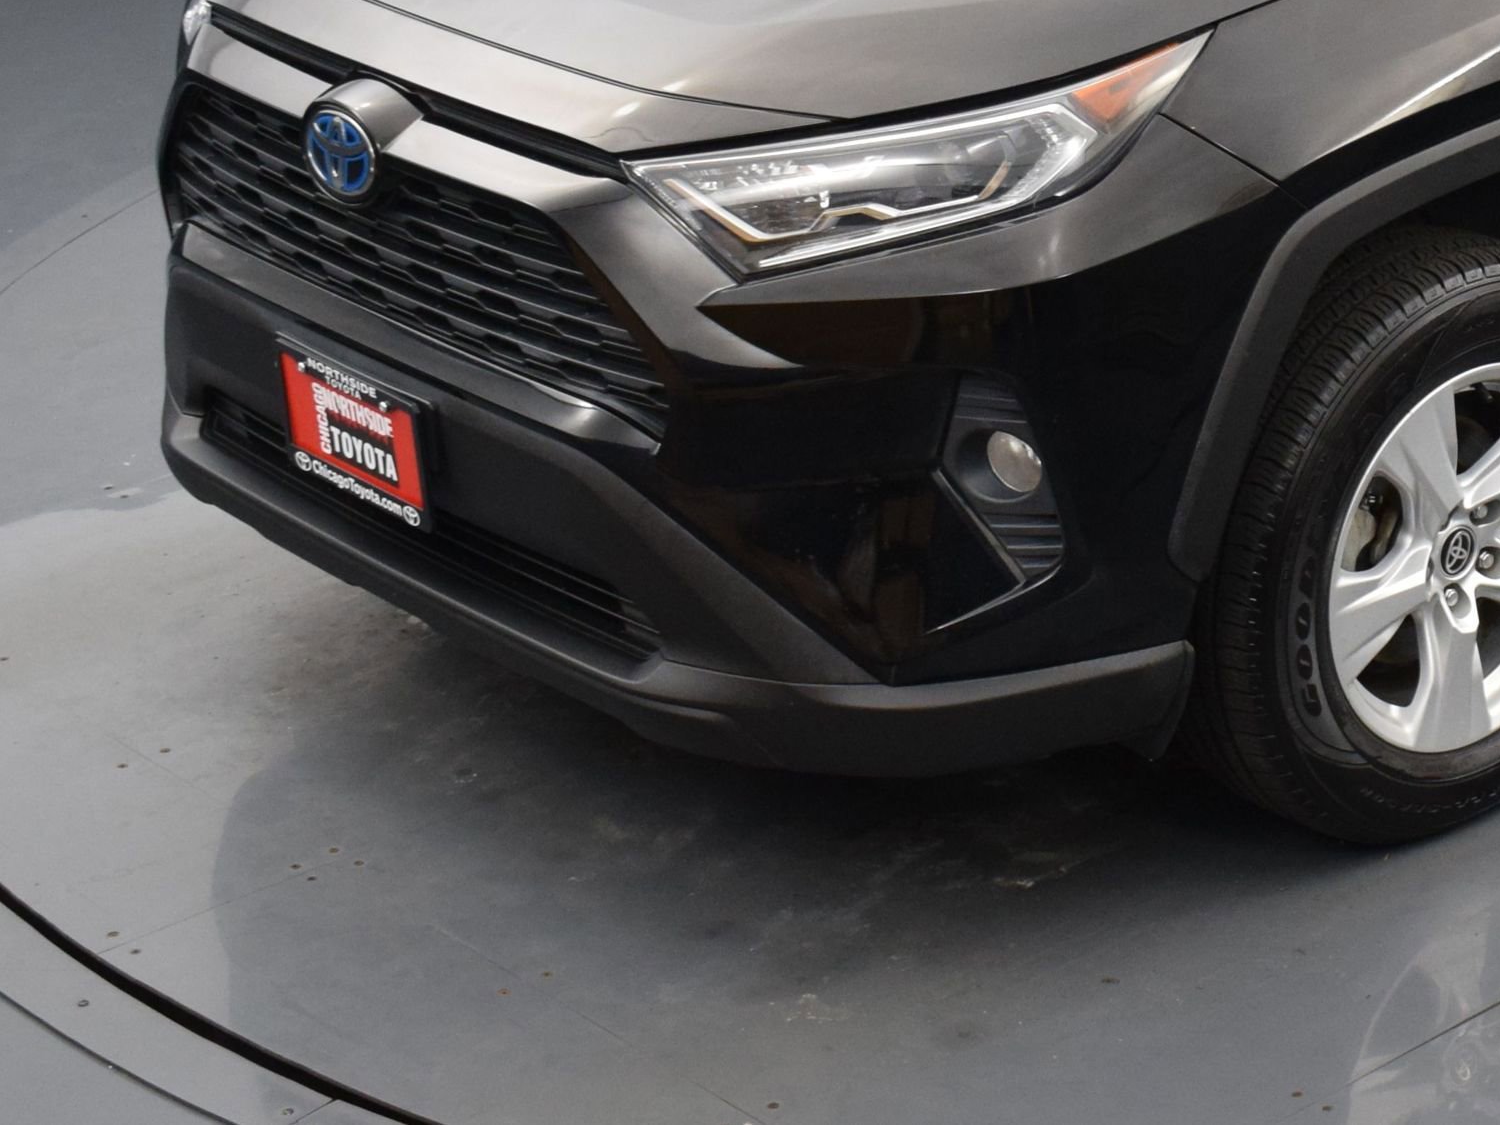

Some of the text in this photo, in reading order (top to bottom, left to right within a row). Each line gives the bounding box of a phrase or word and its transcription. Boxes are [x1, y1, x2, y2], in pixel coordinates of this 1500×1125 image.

[306, 357, 378, 399] NORTHSIDE
[324, 375, 362, 401] TOYOTA
[329, 424, 399, 482] TOYOTA
[311, 459, 404, 518] ChicagoToyota.com
